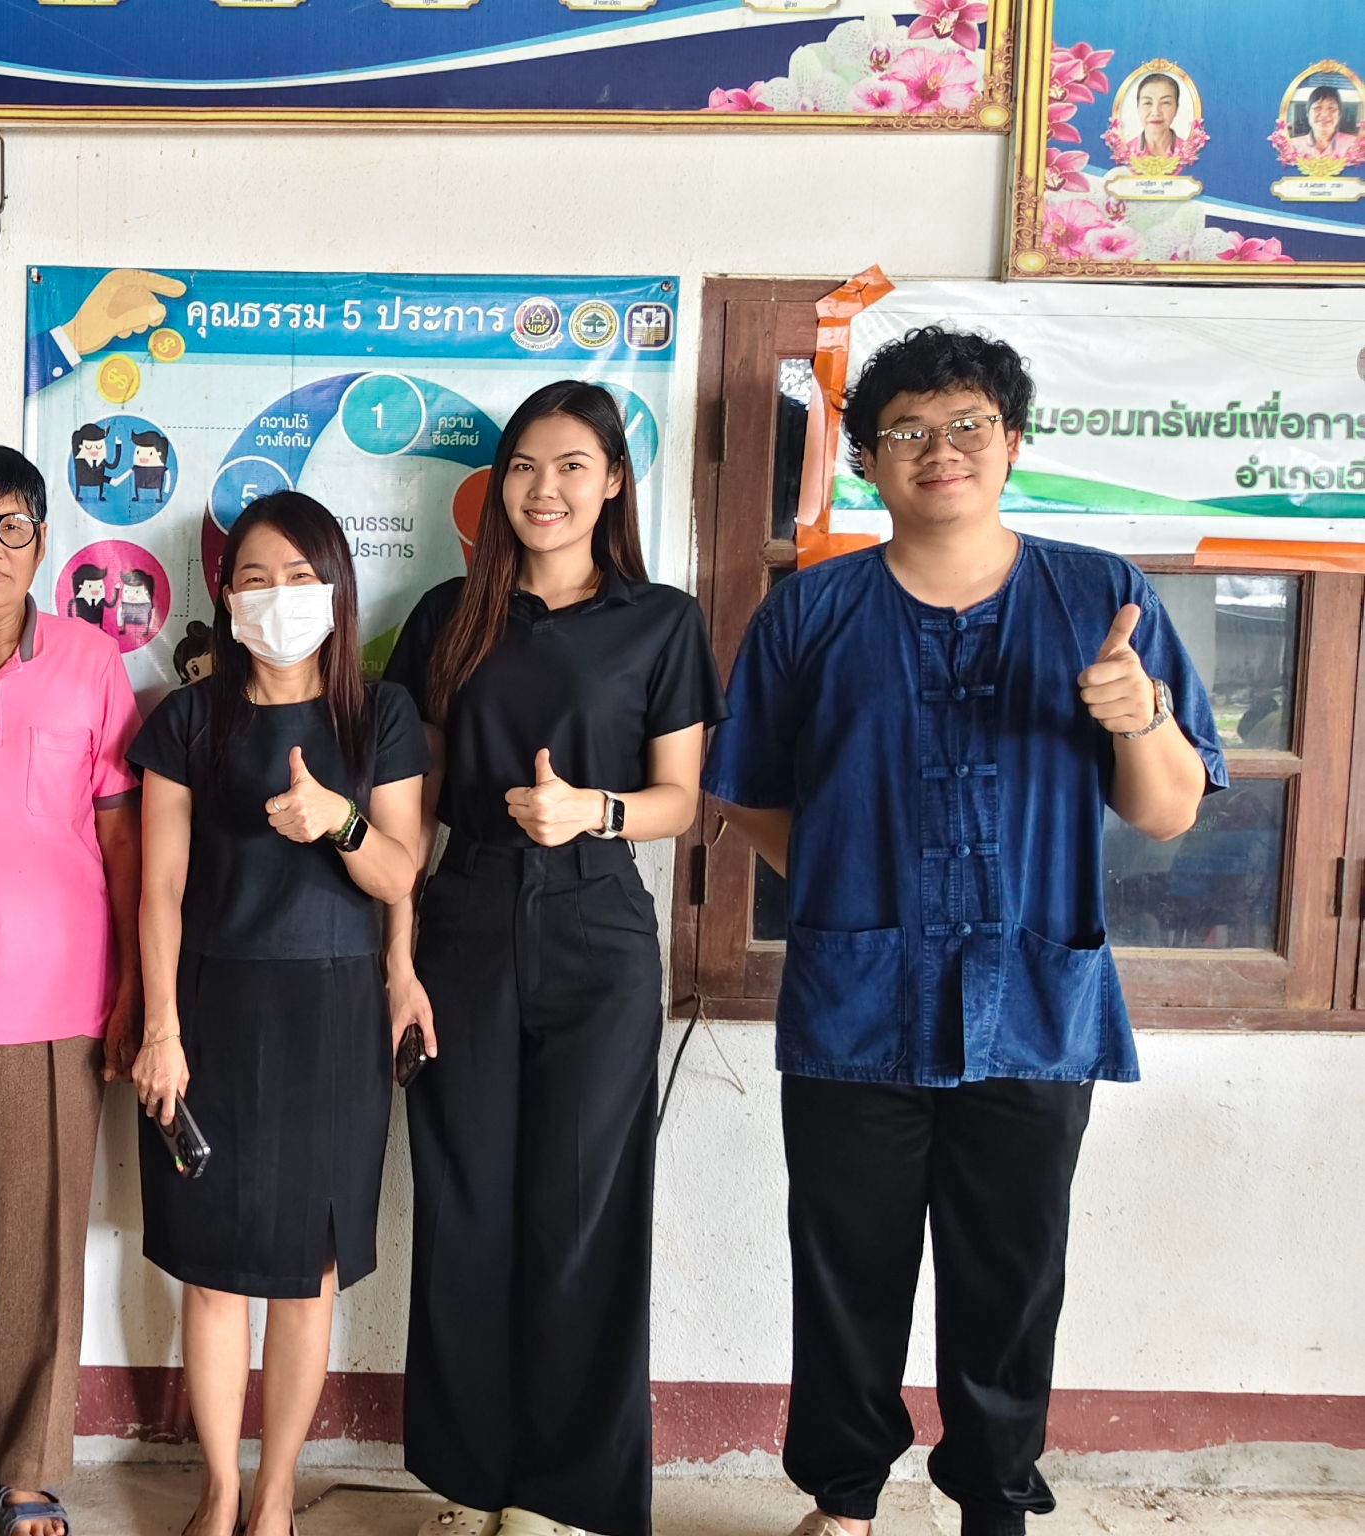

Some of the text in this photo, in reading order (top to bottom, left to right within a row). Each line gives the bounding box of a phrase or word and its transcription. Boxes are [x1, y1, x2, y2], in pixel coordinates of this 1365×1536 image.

[186, 295, 508, 339] คุณธรรม 5 ประการ
[259, 412, 309, 429] ความไว้
[371, 403, 384, 429] 1
[438, 416, 474, 429] ความ
[255, 431, 312, 448] วางใจกัน
[240, 483, 258, 509] 5
